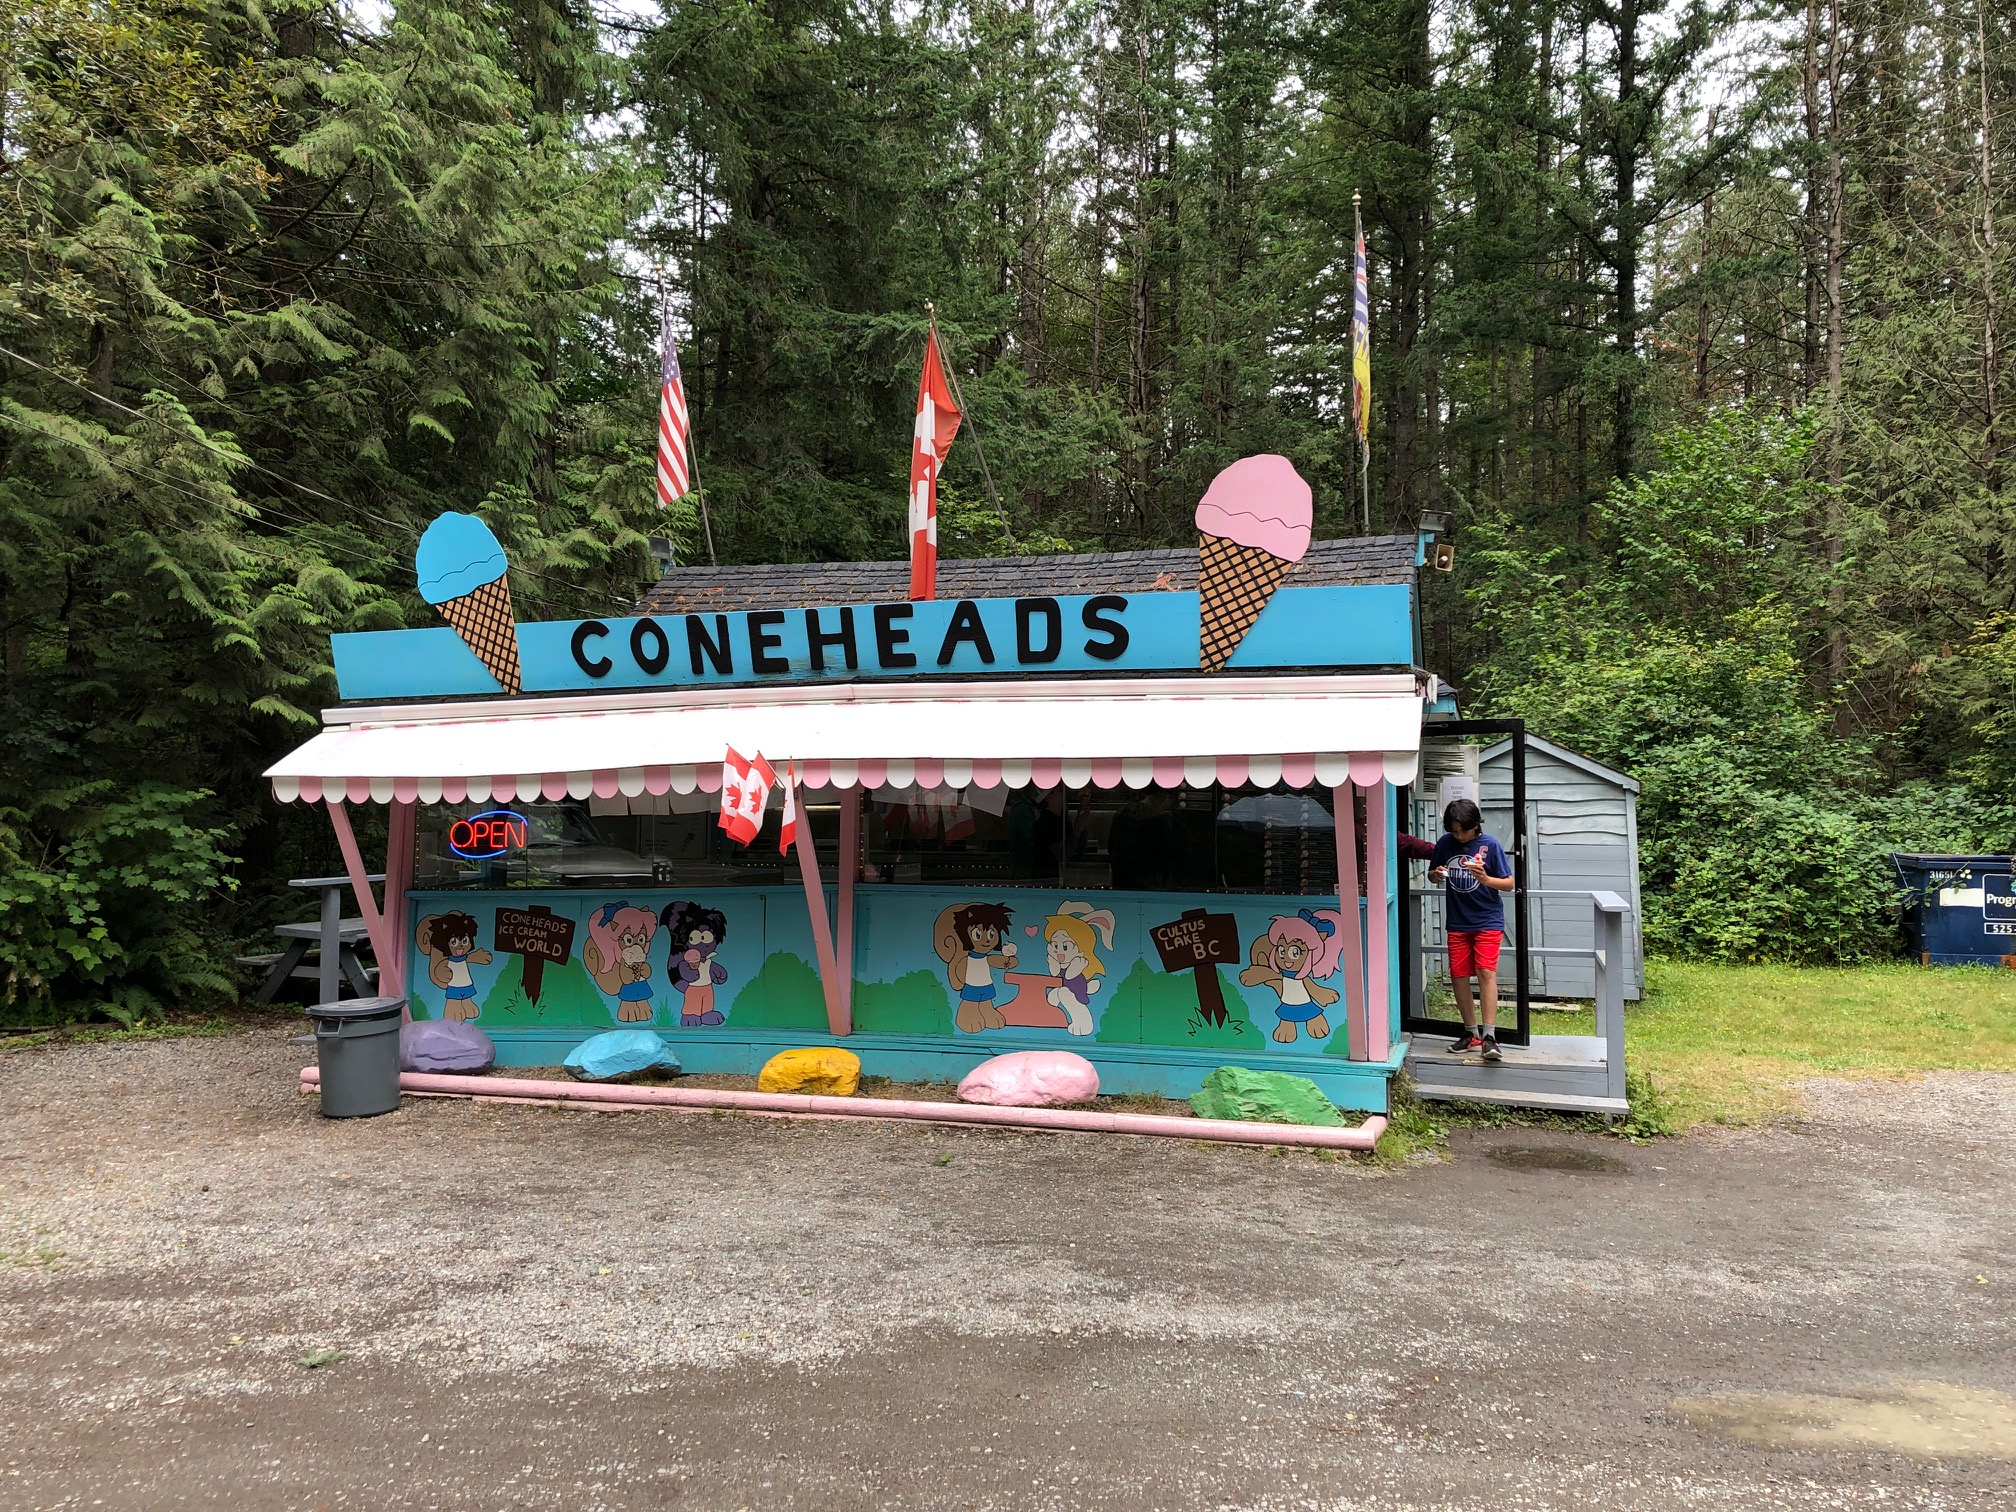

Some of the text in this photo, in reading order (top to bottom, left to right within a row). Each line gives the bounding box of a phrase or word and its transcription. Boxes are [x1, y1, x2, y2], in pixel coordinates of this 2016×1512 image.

[570, 595, 1130, 678] CONEHEADS
[449, 820, 526, 848] OPEN
[498, 925, 548, 939] ICE CREAM
[502, 912, 568, 934] CONEHEADS
[1157, 919, 1205, 941] CULTUS
[513, 936, 563, 957] WORLD
[1165, 932, 1201, 950] LAKE
